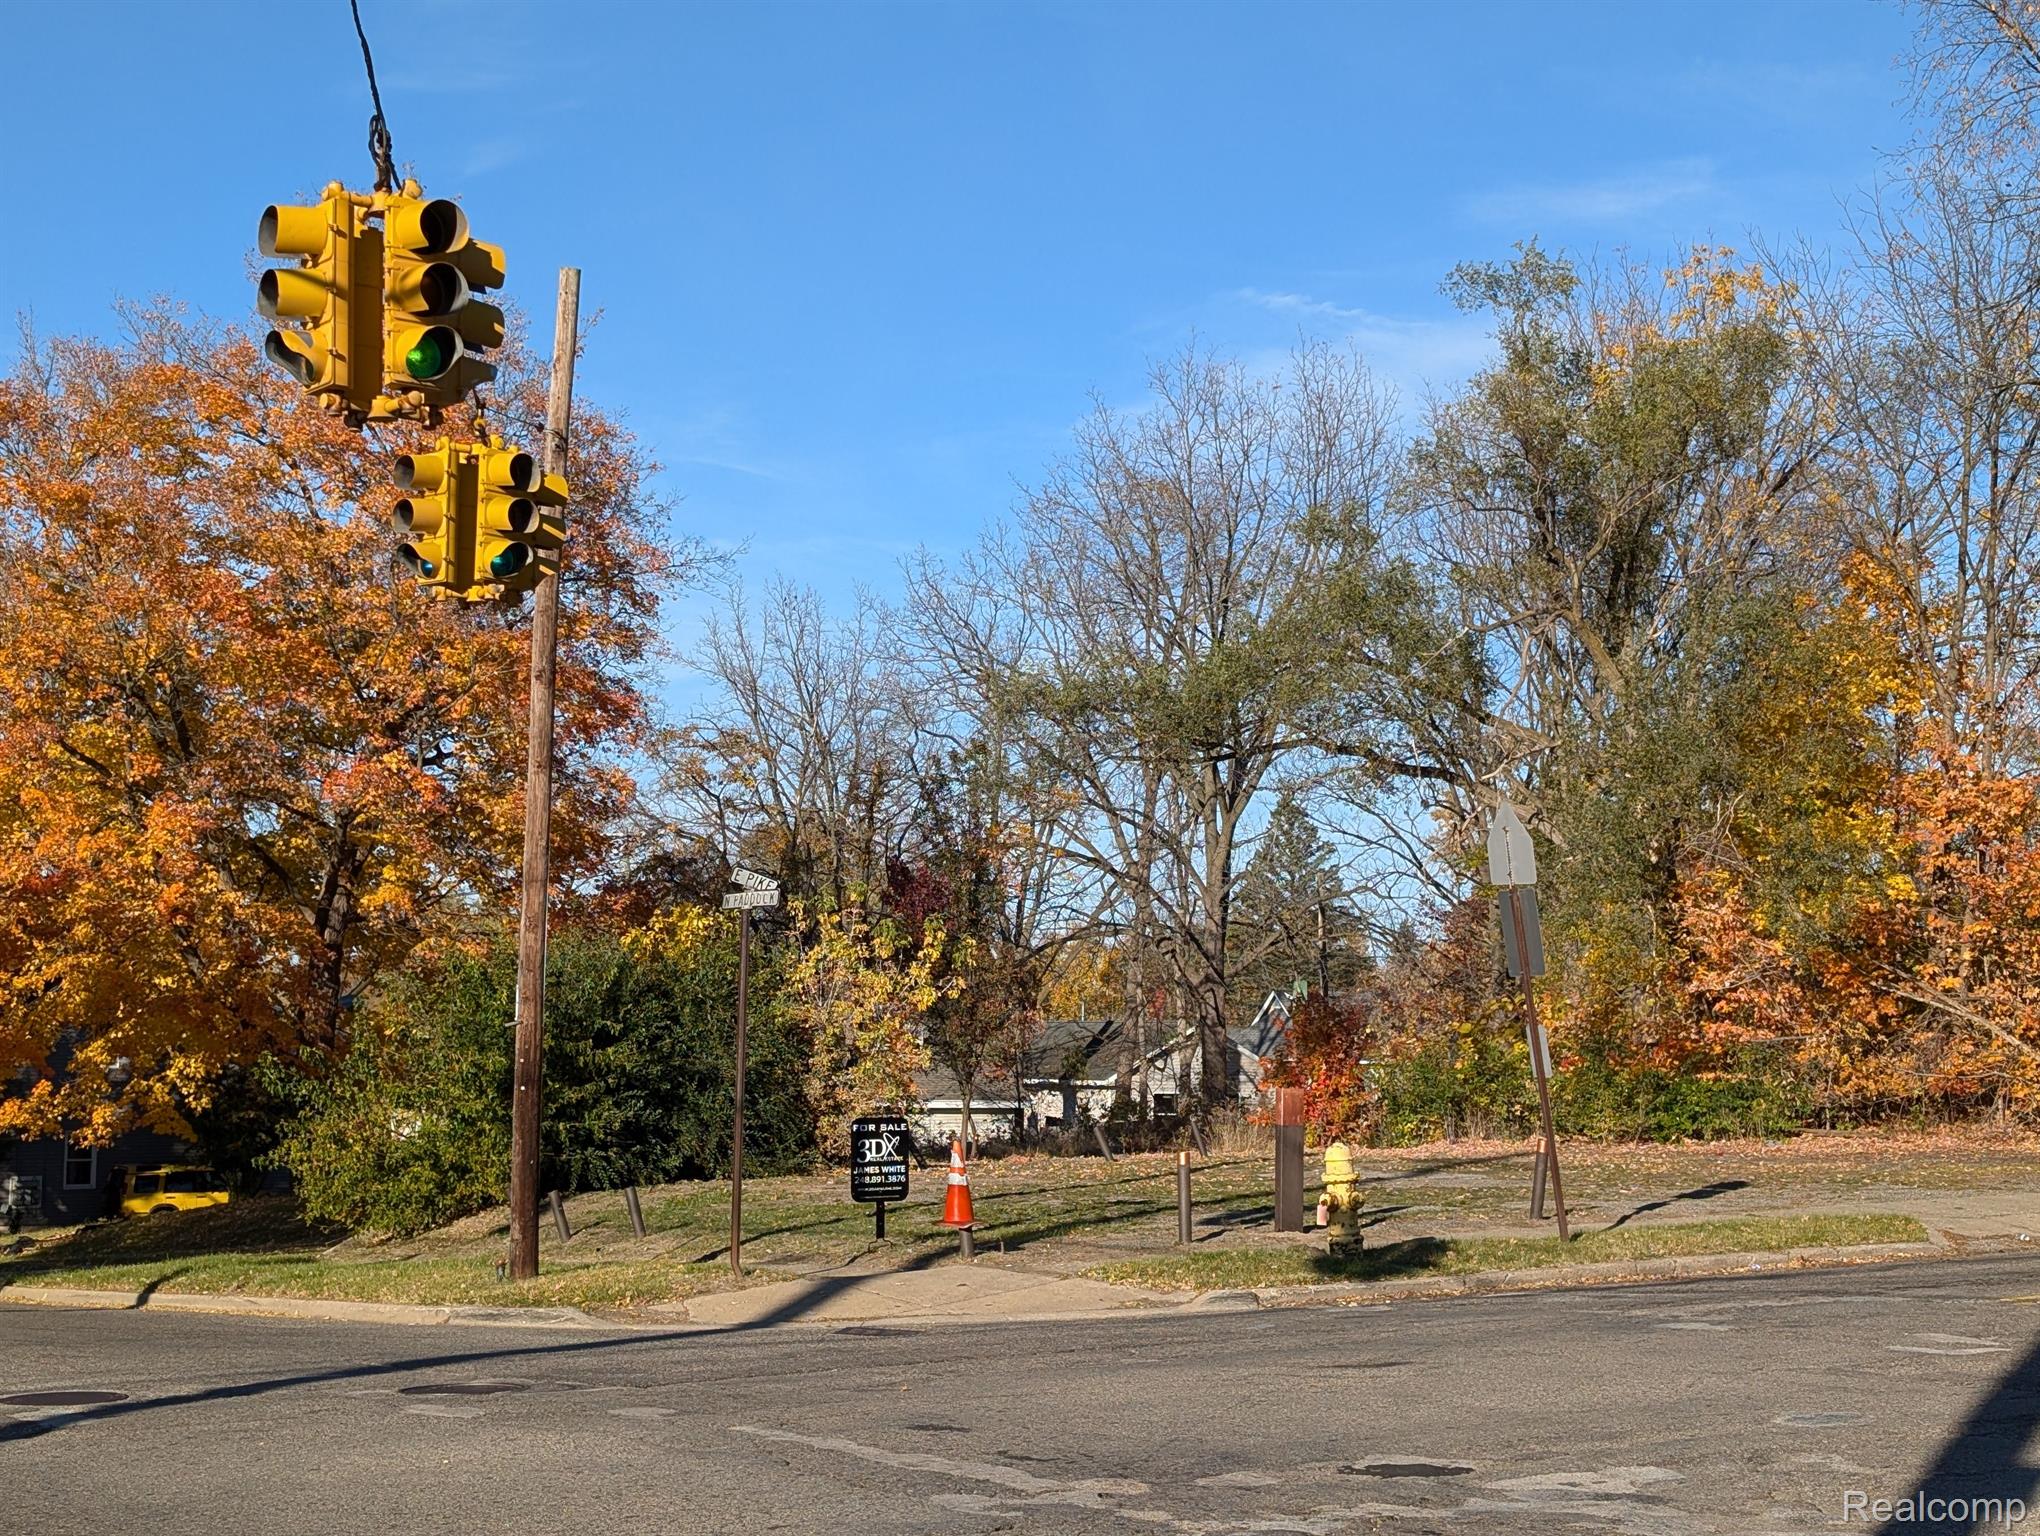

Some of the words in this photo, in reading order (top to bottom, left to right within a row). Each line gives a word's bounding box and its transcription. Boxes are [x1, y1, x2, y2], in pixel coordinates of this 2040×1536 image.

[734, 869, 743, 881] E
[724, 895, 730, 906] N
[734, 893, 775, 905] PADDOCK
[853, 1124, 875, 1132] FOR
[880, 1123, 906, 1131] SALE
[854, 1166, 880, 1174] JAMES
[881, 1165, 906, 1173] WHITE
